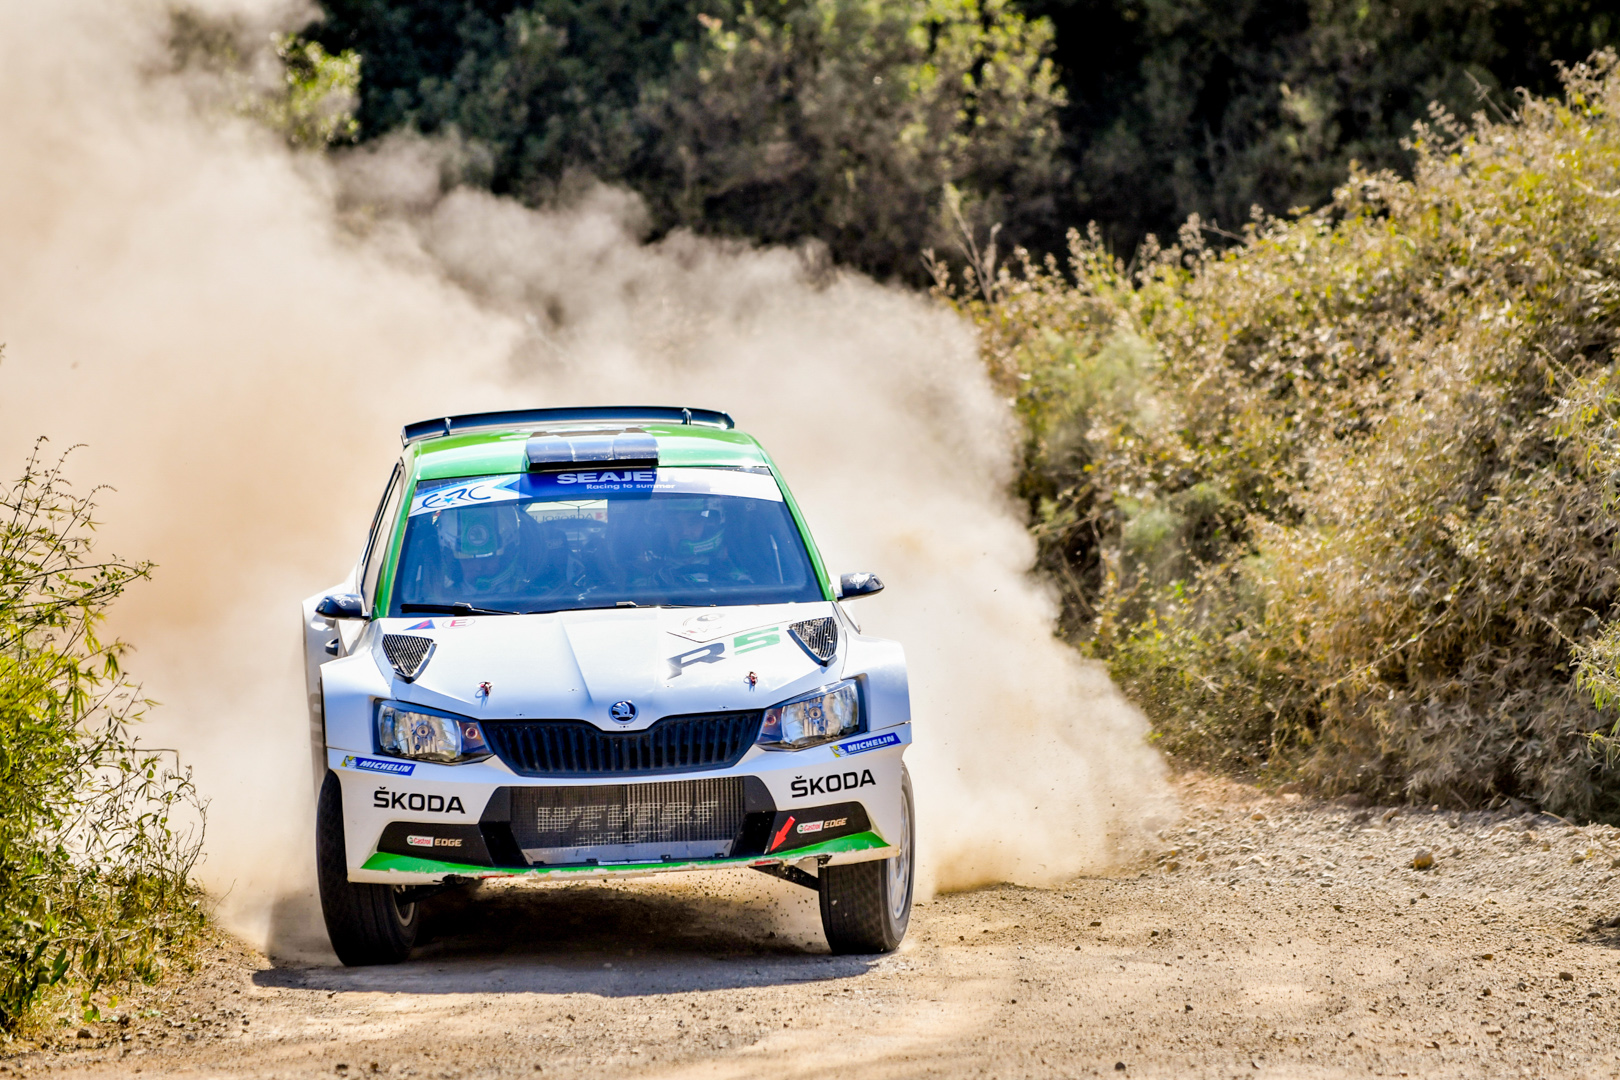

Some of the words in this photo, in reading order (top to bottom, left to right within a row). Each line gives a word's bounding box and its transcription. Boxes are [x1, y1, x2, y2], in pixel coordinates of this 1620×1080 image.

[666, 626, 780, 680] R5
[847, 735, 895, 752] MICHELIN
[360, 760, 412, 772] MICHELIN
[790, 769, 877, 798] ŠKODA
[373, 786, 466, 814] ŠKODA
[803, 822, 821, 832] Castrol
[824, 817, 848, 829] EDGE
[413, 836, 432, 846] Castrol
[434, 838, 463, 847] EDGE
